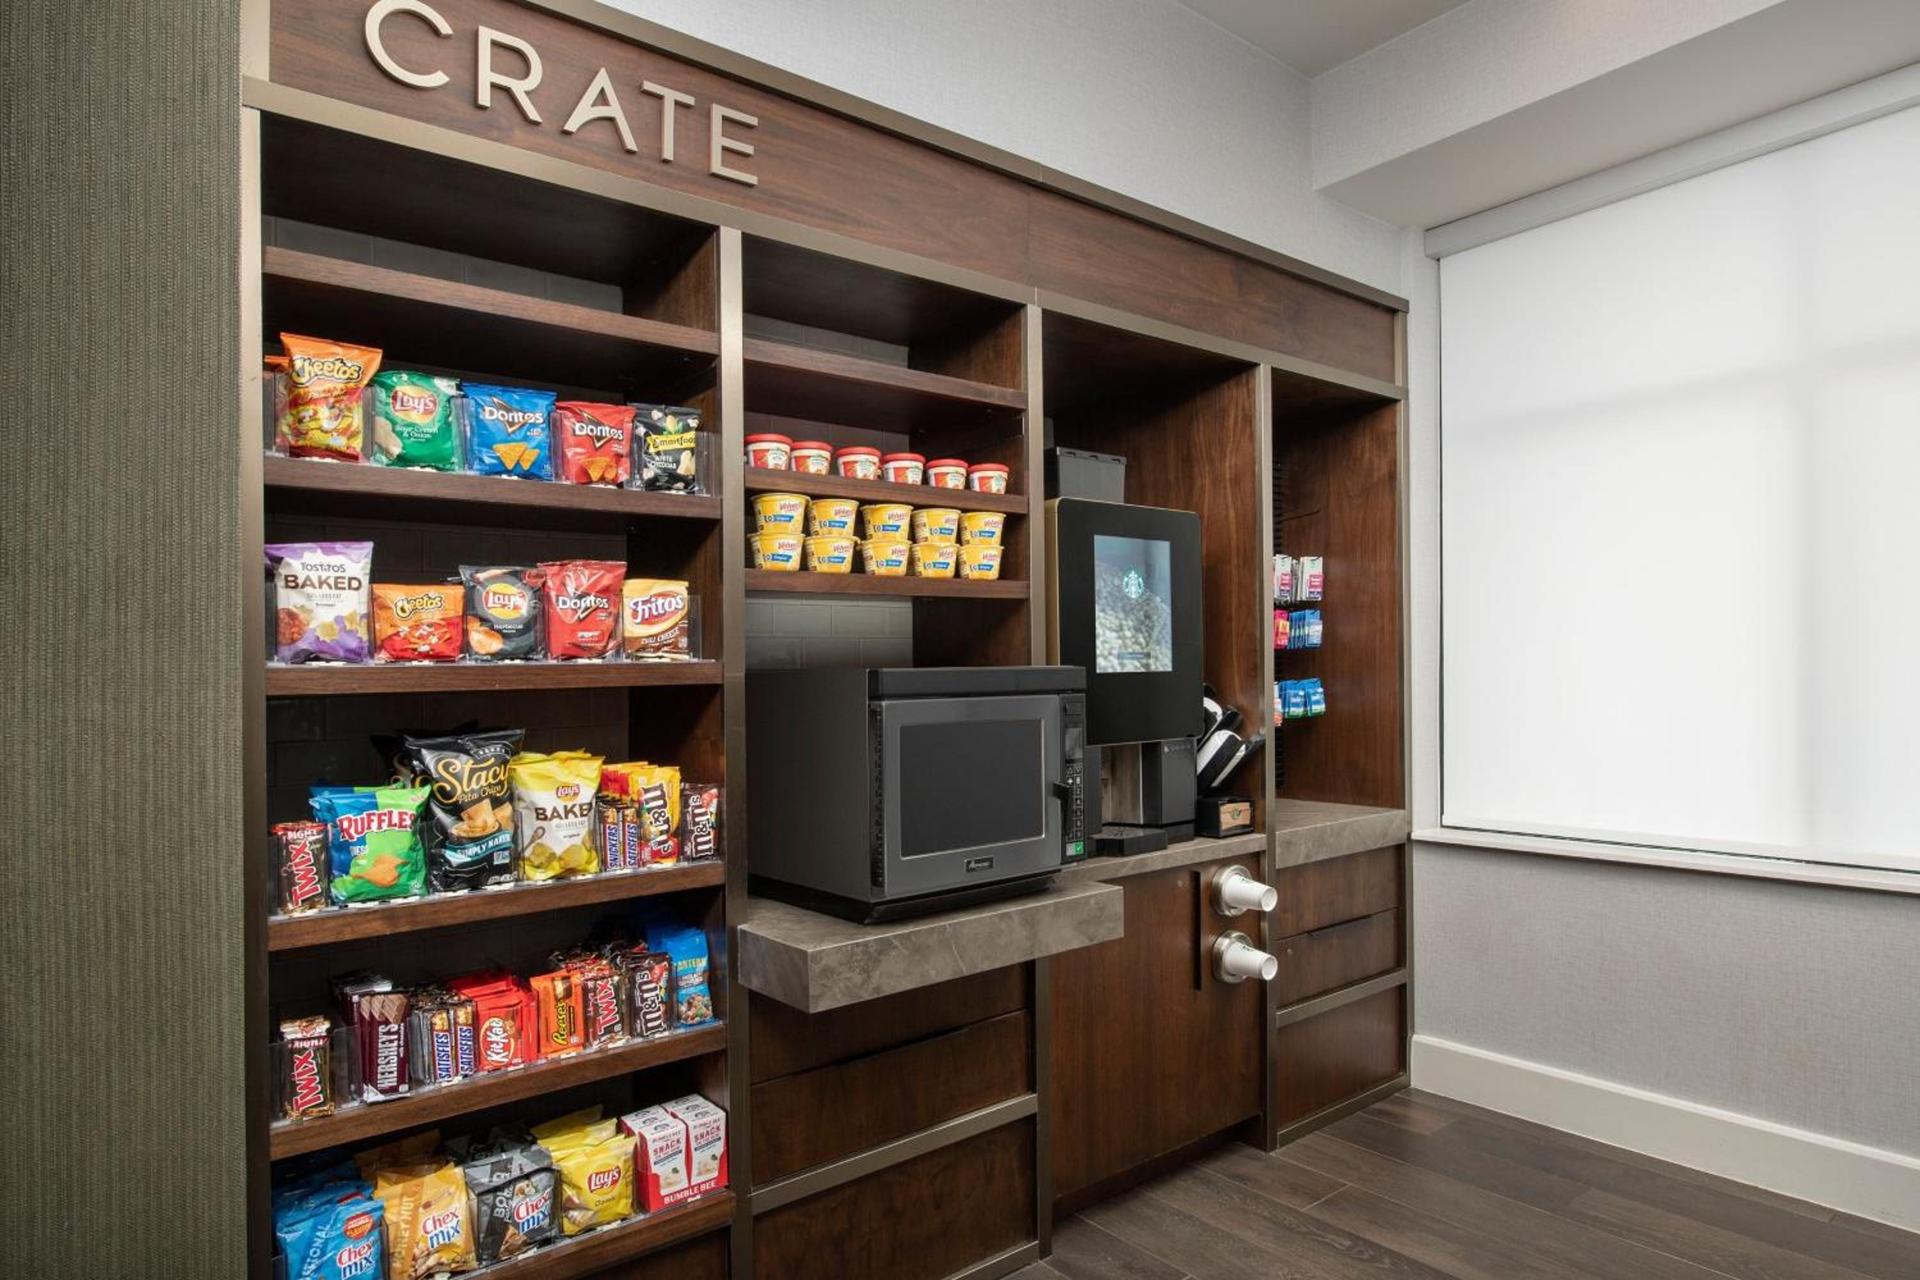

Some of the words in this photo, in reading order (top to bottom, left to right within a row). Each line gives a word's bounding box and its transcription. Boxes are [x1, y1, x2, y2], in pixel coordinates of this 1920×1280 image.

[363, 0, 759, 187] CRATE
[292, 356, 362, 386] Cheetos
[394, 388, 436, 415] Lay's
[484, 406, 544, 424] Doritos
[574, 421, 624, 440] Doritos
[652, 434, 695, 449] Smartfoo
[284, 574, 362, 591] BAKED
[394, 594, 443, 618] Cheetos
[487, 591, 525, 610] Lay's
[558, 595, 609, 609] Doritos
[630, 593, 684, 624] Fritos
[336, 810, 416, 841] RUFFLES
[607, 825, 619, 868] SNICKERS
[626, 824, 638, 867] SATISFIES
[289, 838, 321, 907] TWIX
[596, 978, 619, 1035] TWIX
[377, 1024, 399, 1089] HERSHEY'S
[436, 1033, 451, 1079] SATISFIES
[459, 1027, 473, 1073] SATISFIES
[292, 1049, 324, 1112] TWIX
[654, 1138, 681, 1156] SNACK
[695, 1125, 720, 1142] SNACK
[591, 1168, 619, 1190] Lay's
[664, 1186, 699, 1205] BUMBLE
[700, 1180, 716, 1191] BEE
[514, 1189, 550, 1221] Chex
[422, 1209, 459, 1235] Chex
[337, 1242, 373, 1267] Chex
